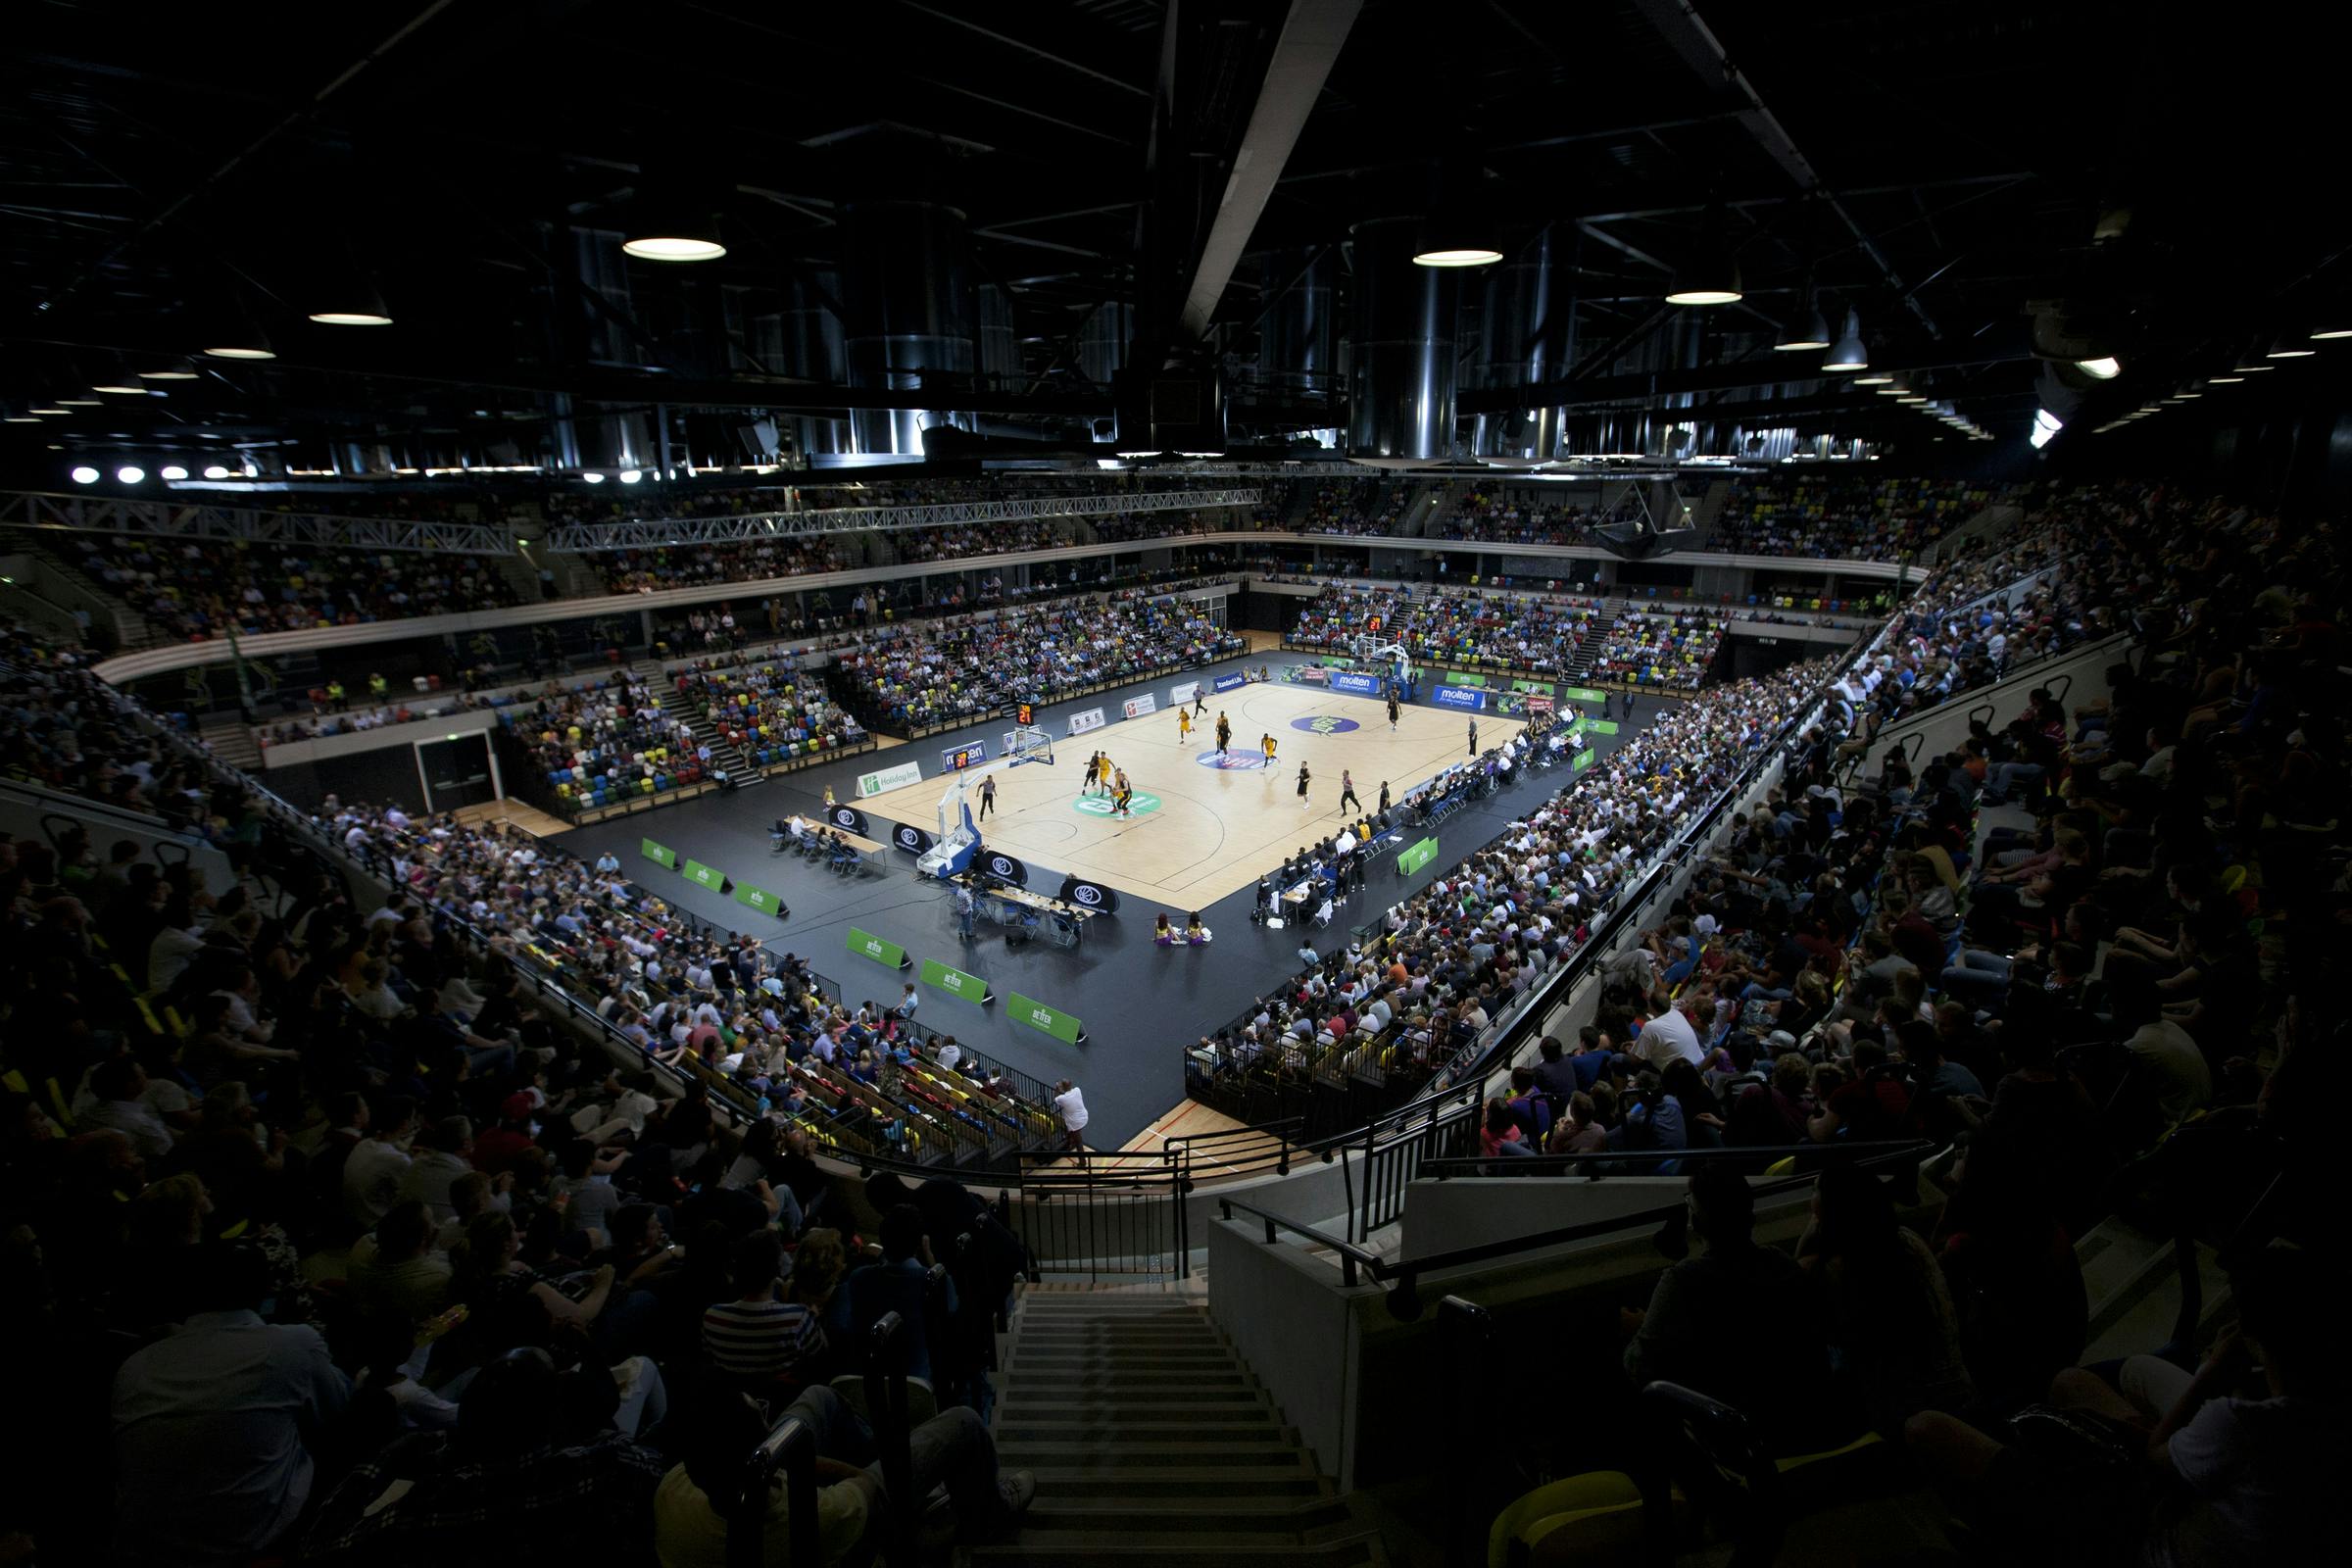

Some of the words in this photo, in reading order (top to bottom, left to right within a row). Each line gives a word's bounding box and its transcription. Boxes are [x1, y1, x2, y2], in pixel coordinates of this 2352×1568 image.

[1216, 679, 1234, 689] Standard
[1339, 676, 1370, 687] molten
[1442, 689, 1474, 702] molten
[881, 774, 906, 785] Holiday
[944, 973, 961, 988] BETTER
[1032, 1009, 1052, 1025] BETTER
